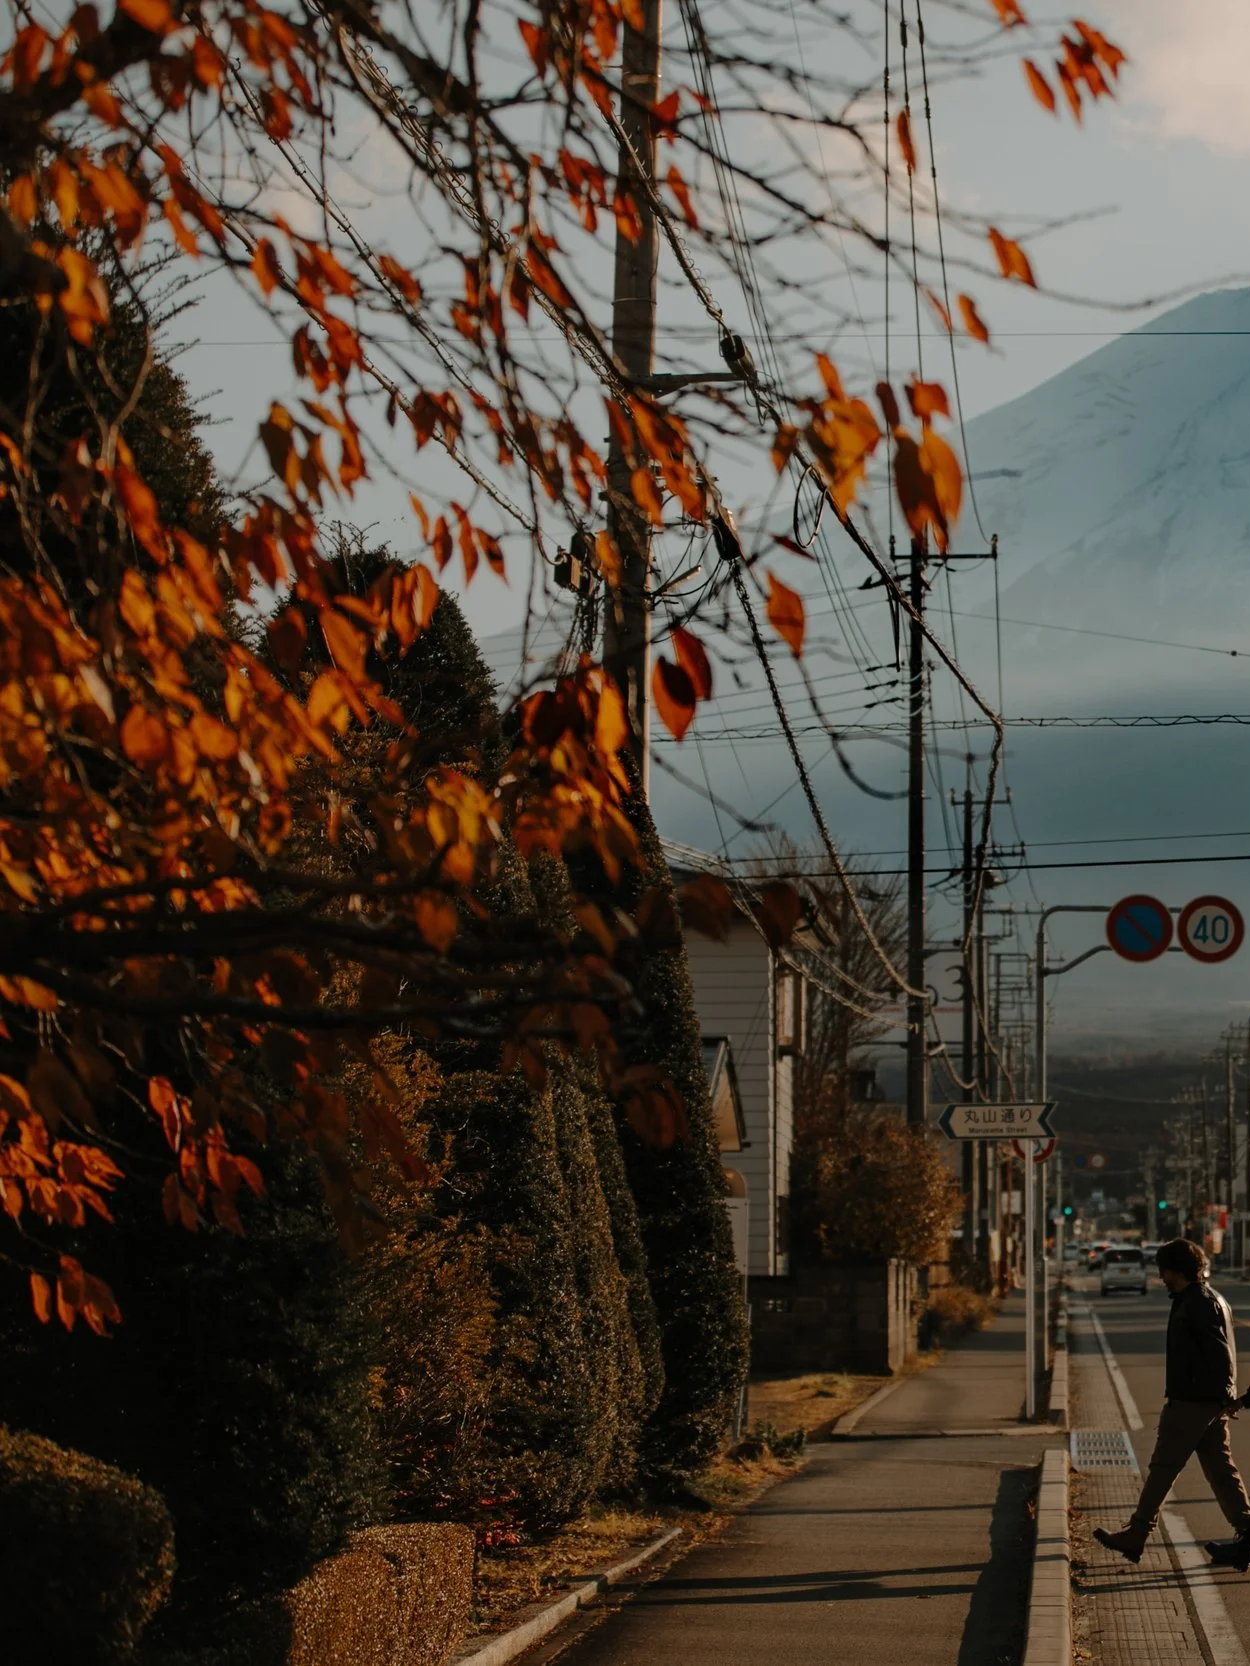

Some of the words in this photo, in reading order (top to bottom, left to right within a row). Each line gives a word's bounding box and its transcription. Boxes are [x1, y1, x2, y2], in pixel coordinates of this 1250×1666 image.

[1193, 915, 1229, 944] 40
[964, 1108, 1032, 1124] 丸山通り
[1006, 1126, 1028, 1134] Street
